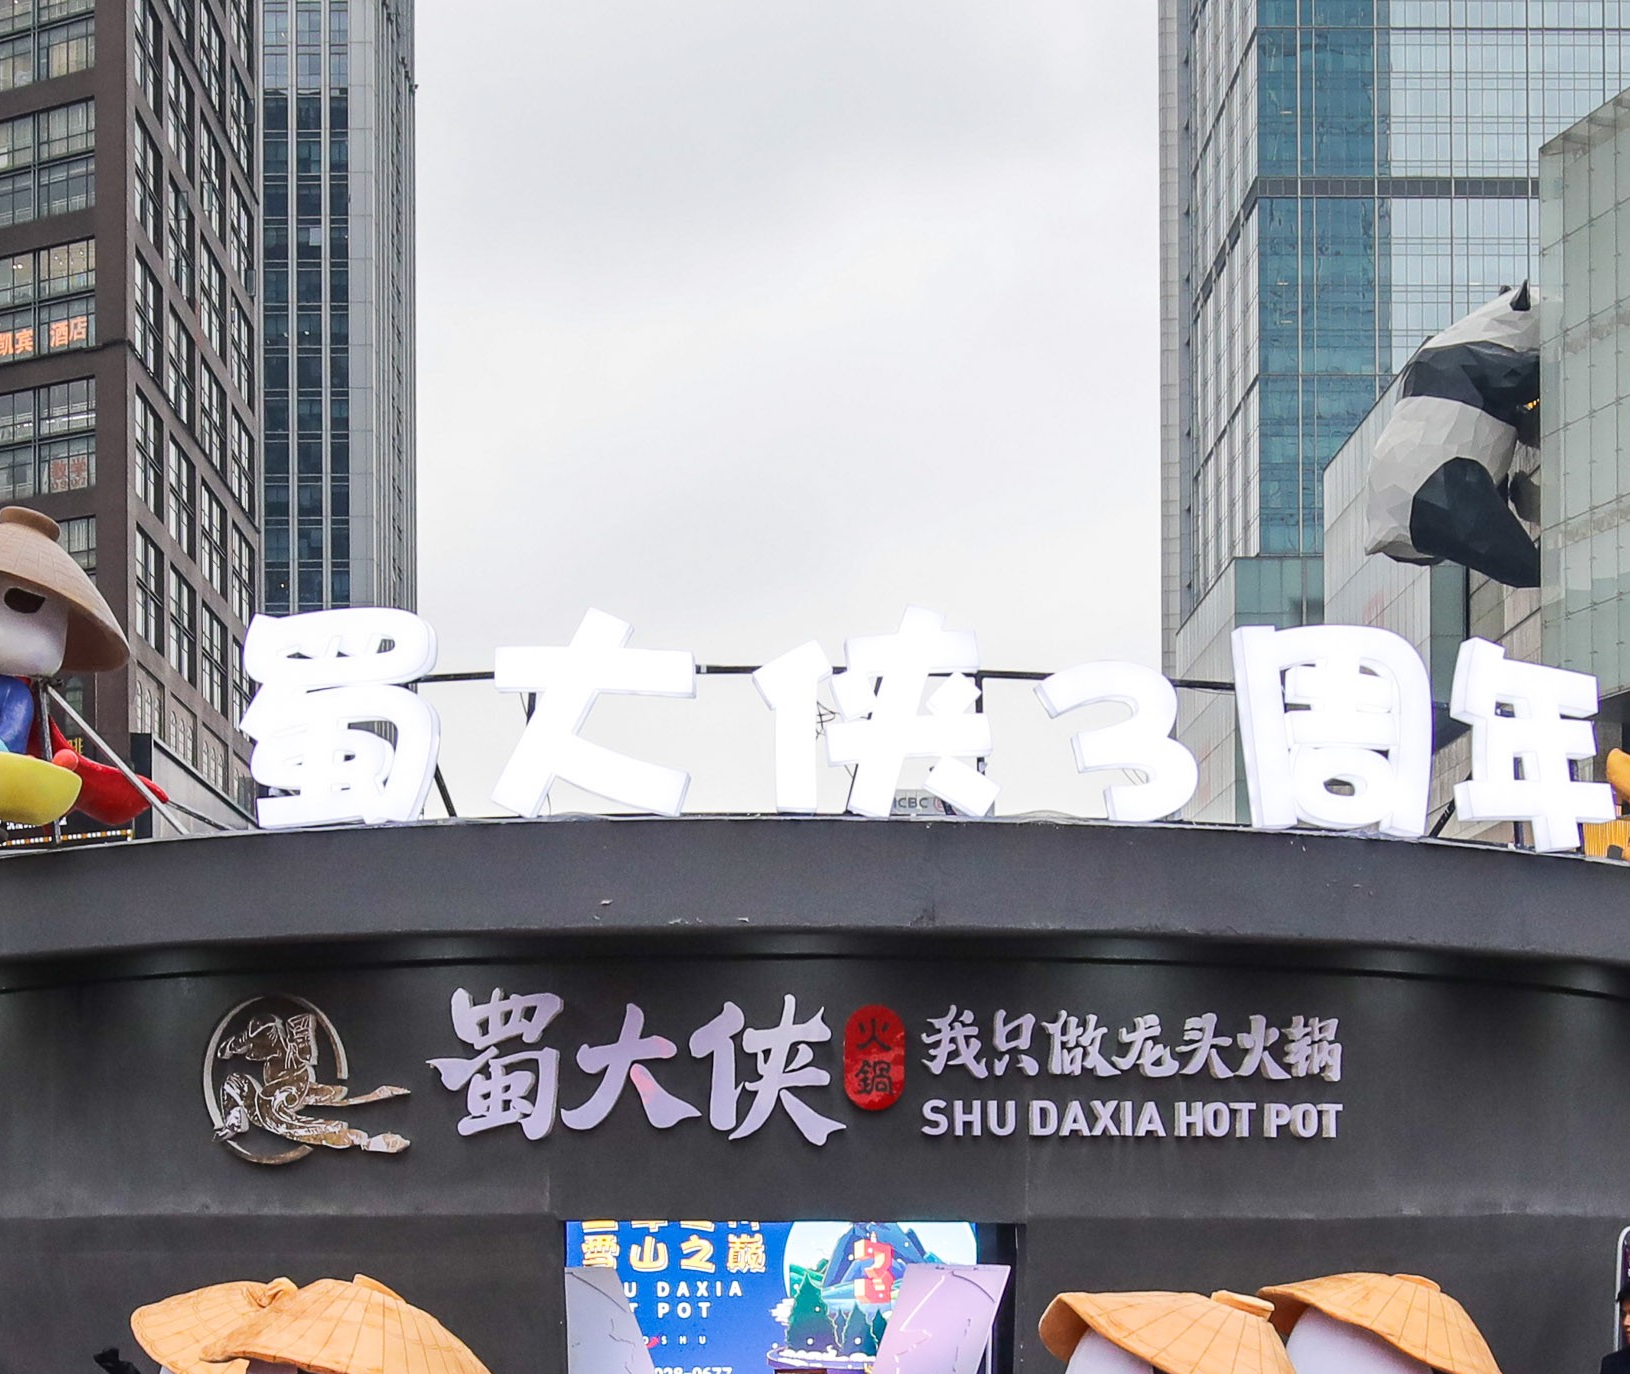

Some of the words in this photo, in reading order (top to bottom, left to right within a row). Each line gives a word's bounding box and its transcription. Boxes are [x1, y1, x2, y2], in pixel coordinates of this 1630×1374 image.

[241, 604, 1619, 852] 蜀大侠3周年
[893, 796, 929, 809] ICBC
[921, 1004, 1343, 1082] 我只做龙头火锅
[426, 987, 847, 1146] 蜀大侠
[921, 1100, 1017, 1138] SHU
[1028, 1100, 1167, 1138] DAXIA
[1174, 1101, 1257, 1138] HOT
[1263, 1102, 1344, 1139] POT
[581, 1233, 766, 1274] 雪山之巅
[656, 1281, 743, 1298] DAXIA
[657, 1302, 711, 1319] POT
